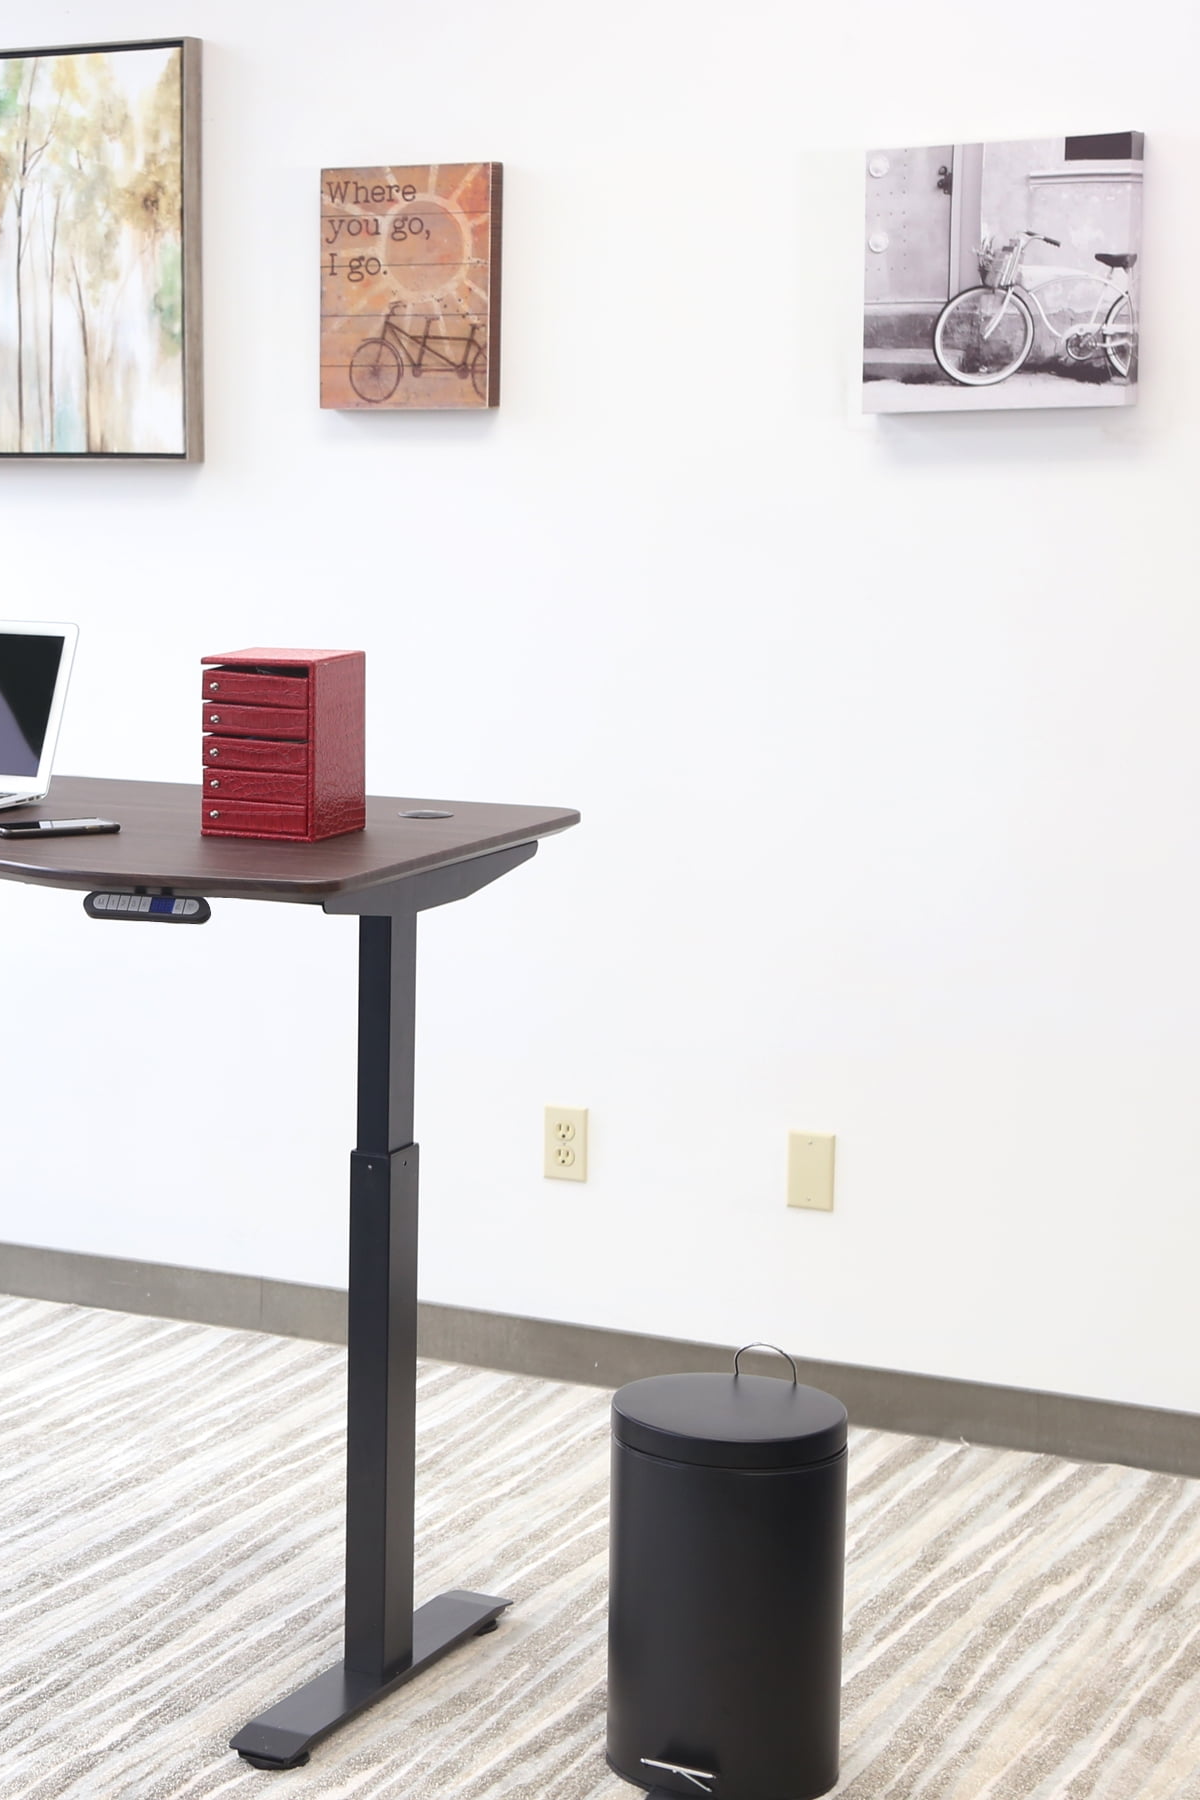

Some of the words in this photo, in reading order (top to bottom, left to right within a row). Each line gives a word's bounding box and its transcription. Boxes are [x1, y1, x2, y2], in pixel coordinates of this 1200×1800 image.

[326, 181, 416, 204] Where
[326, 217, 381, 244] you
[391, 216, 431, 241] go,
[329, 253, 338, 276] I
[347, 256, 387, 282] go.
